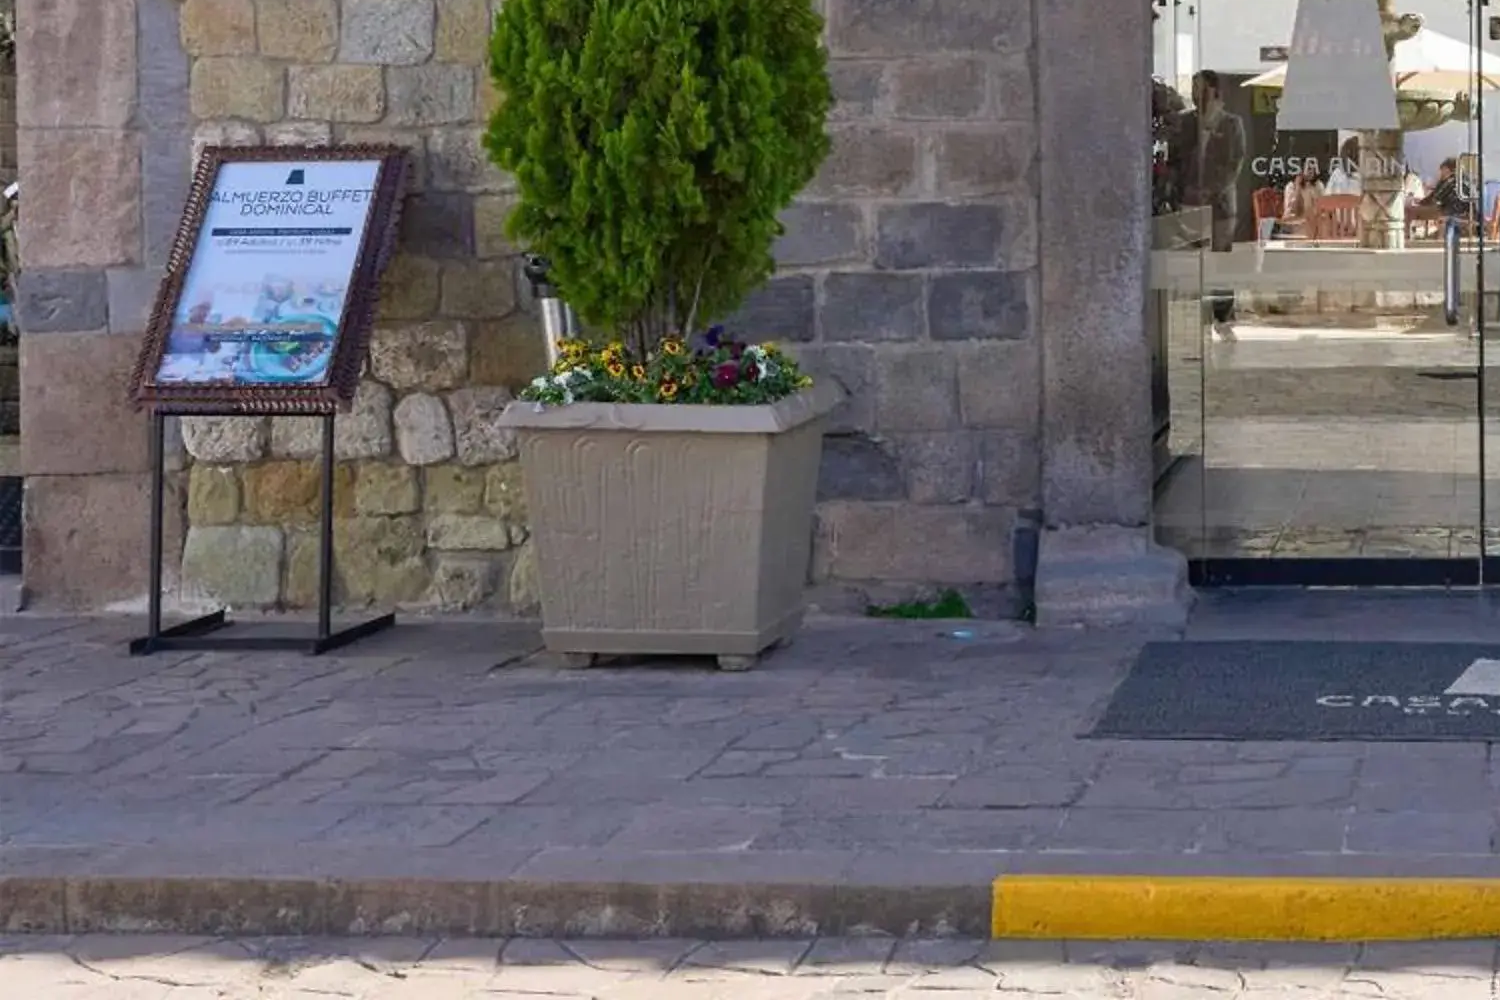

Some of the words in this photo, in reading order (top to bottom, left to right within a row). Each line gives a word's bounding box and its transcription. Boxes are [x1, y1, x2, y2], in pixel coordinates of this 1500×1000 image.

[1251, 157, 1320, 175] CASA
[211, 190, 304, 204] ALMUERZO
[306, 189, 374, 204] BUFFET
[240, 203, 333, 217] DOMINICAL
[1315, 695, 1489, 708] CASA
